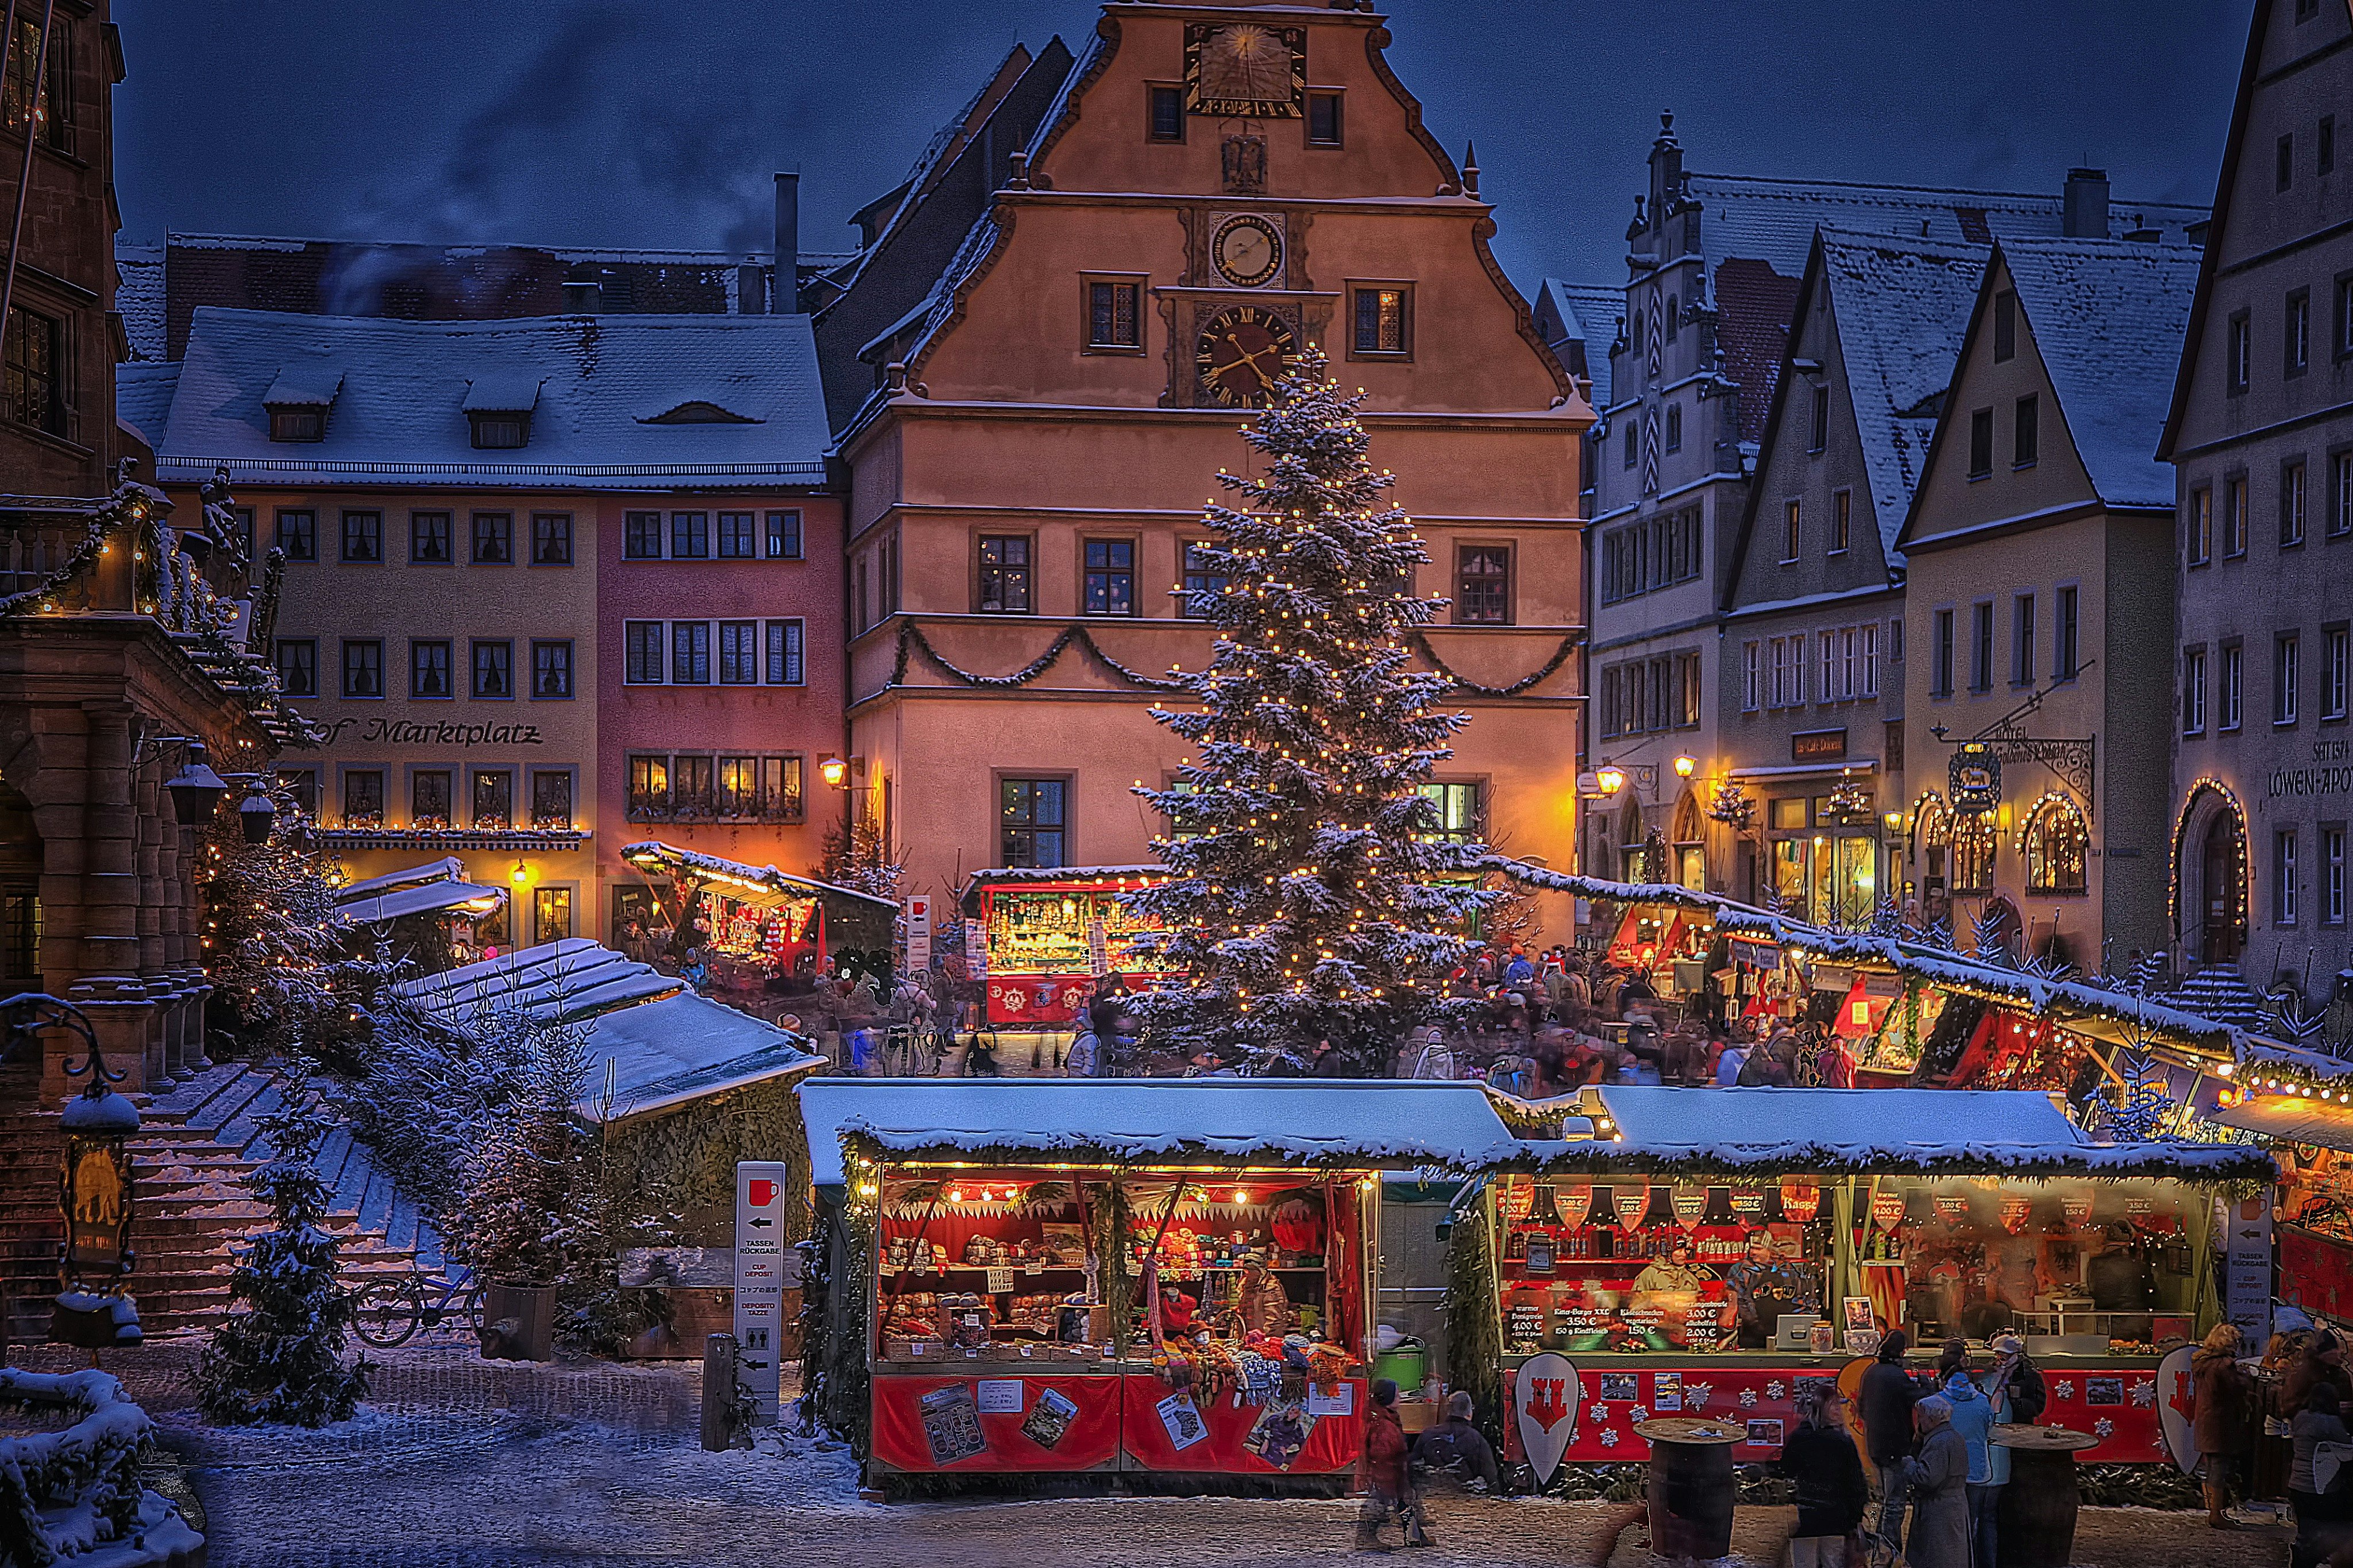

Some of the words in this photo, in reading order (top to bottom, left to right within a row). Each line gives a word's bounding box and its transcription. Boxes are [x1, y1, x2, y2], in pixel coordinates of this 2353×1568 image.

[1239, 307, 1255, 323] XII
[362, 717, 543, 748] Marktplatz
[2269, 766, 2353, 797] LÖWEN-APO
[1784, 1198, 1817, 1210] Kasse
[1686, 1310, 1706, 1318] 3.00
[1708, 1310, 1716, 1318] €
[1567, 1318, 1587, 1326] 3.50
[1588, 1317, 1597, 1326] €
[1512, 1322, 1532, 1331] 4.00
[1534, 1322, 1542, 1330] €
[1647, 1326, 1656, 1334] €
[1686, 1328, 1706, 1337] 2.00
[1708, 1328, 1716, 1337] €
